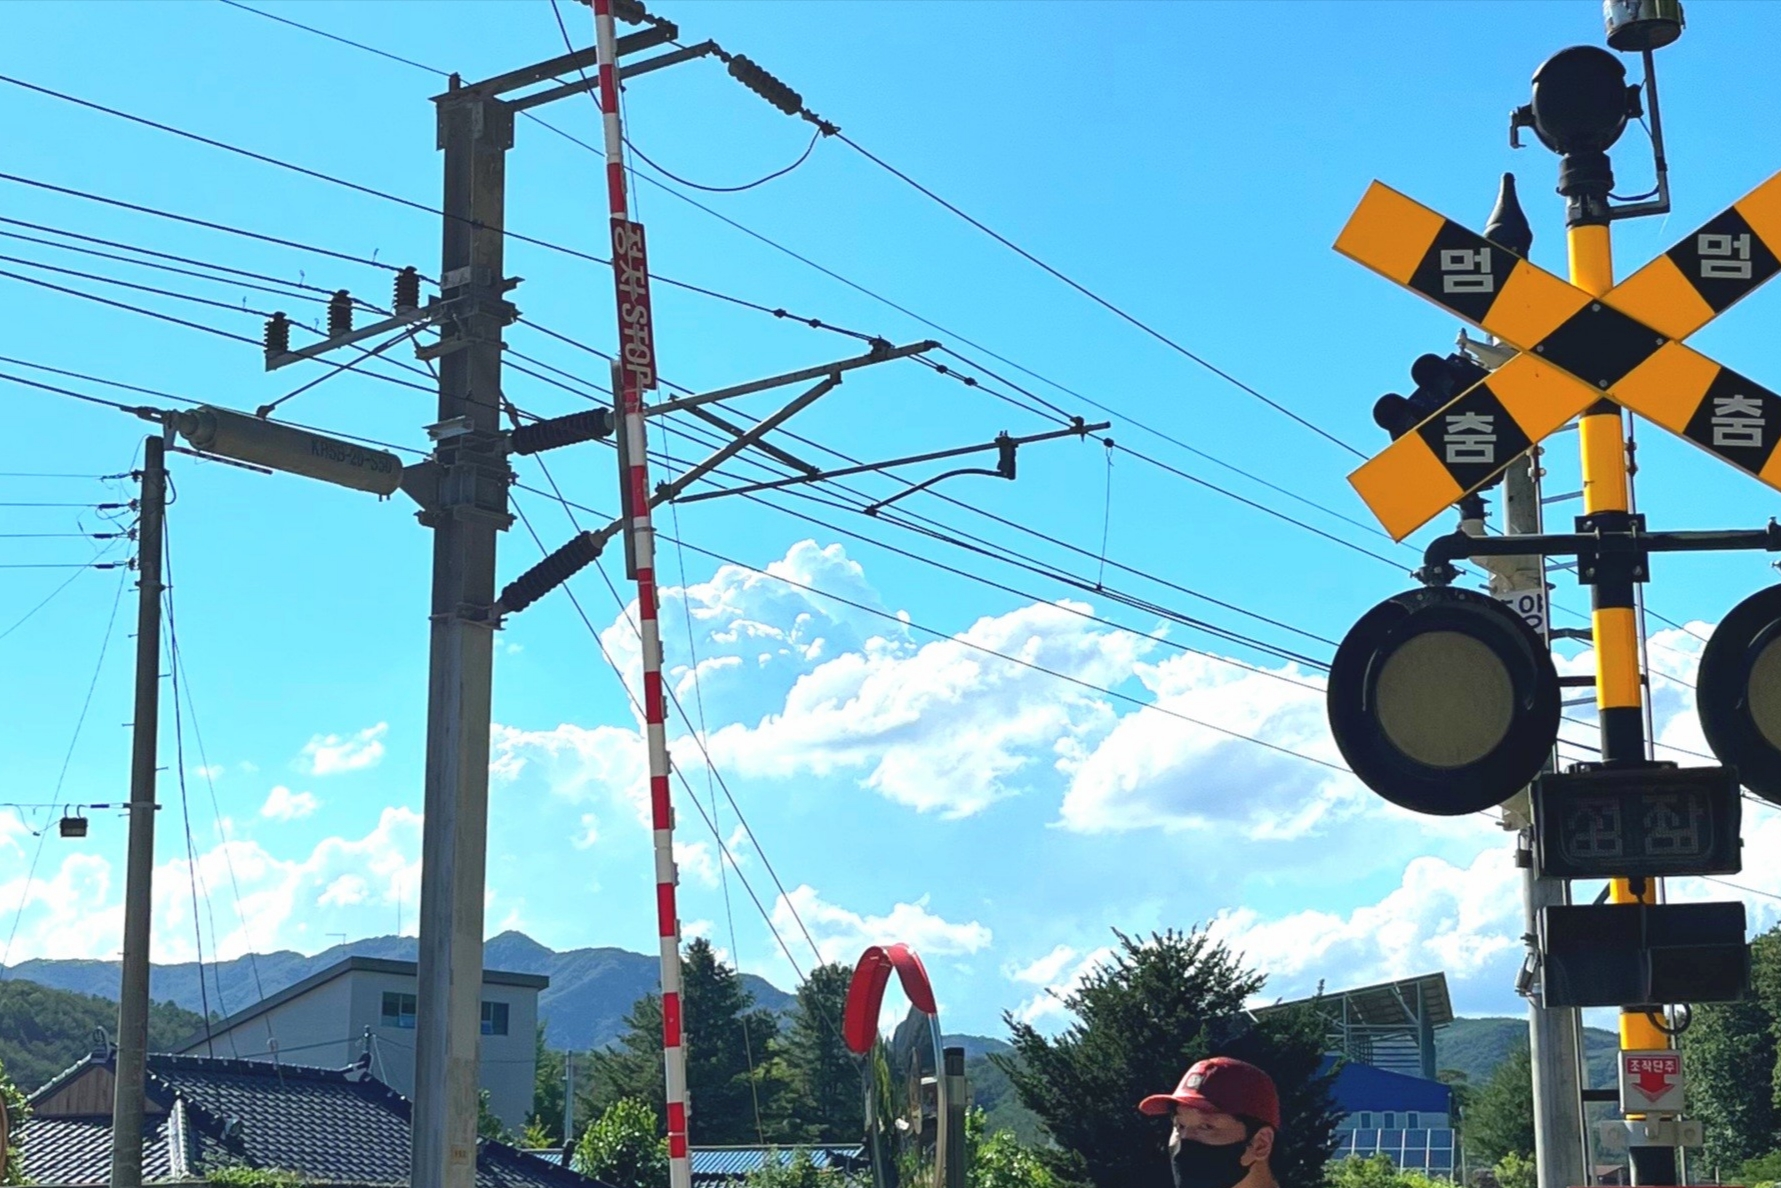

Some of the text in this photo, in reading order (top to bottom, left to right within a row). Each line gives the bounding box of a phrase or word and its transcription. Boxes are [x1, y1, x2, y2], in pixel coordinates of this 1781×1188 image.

[1440, 247, 1494, 293] 멈
[1698, 233, 1752, 279] 멈
[1444, 411, 1497, 463] 춤
[1711, 394, 1765, 447] 춤
